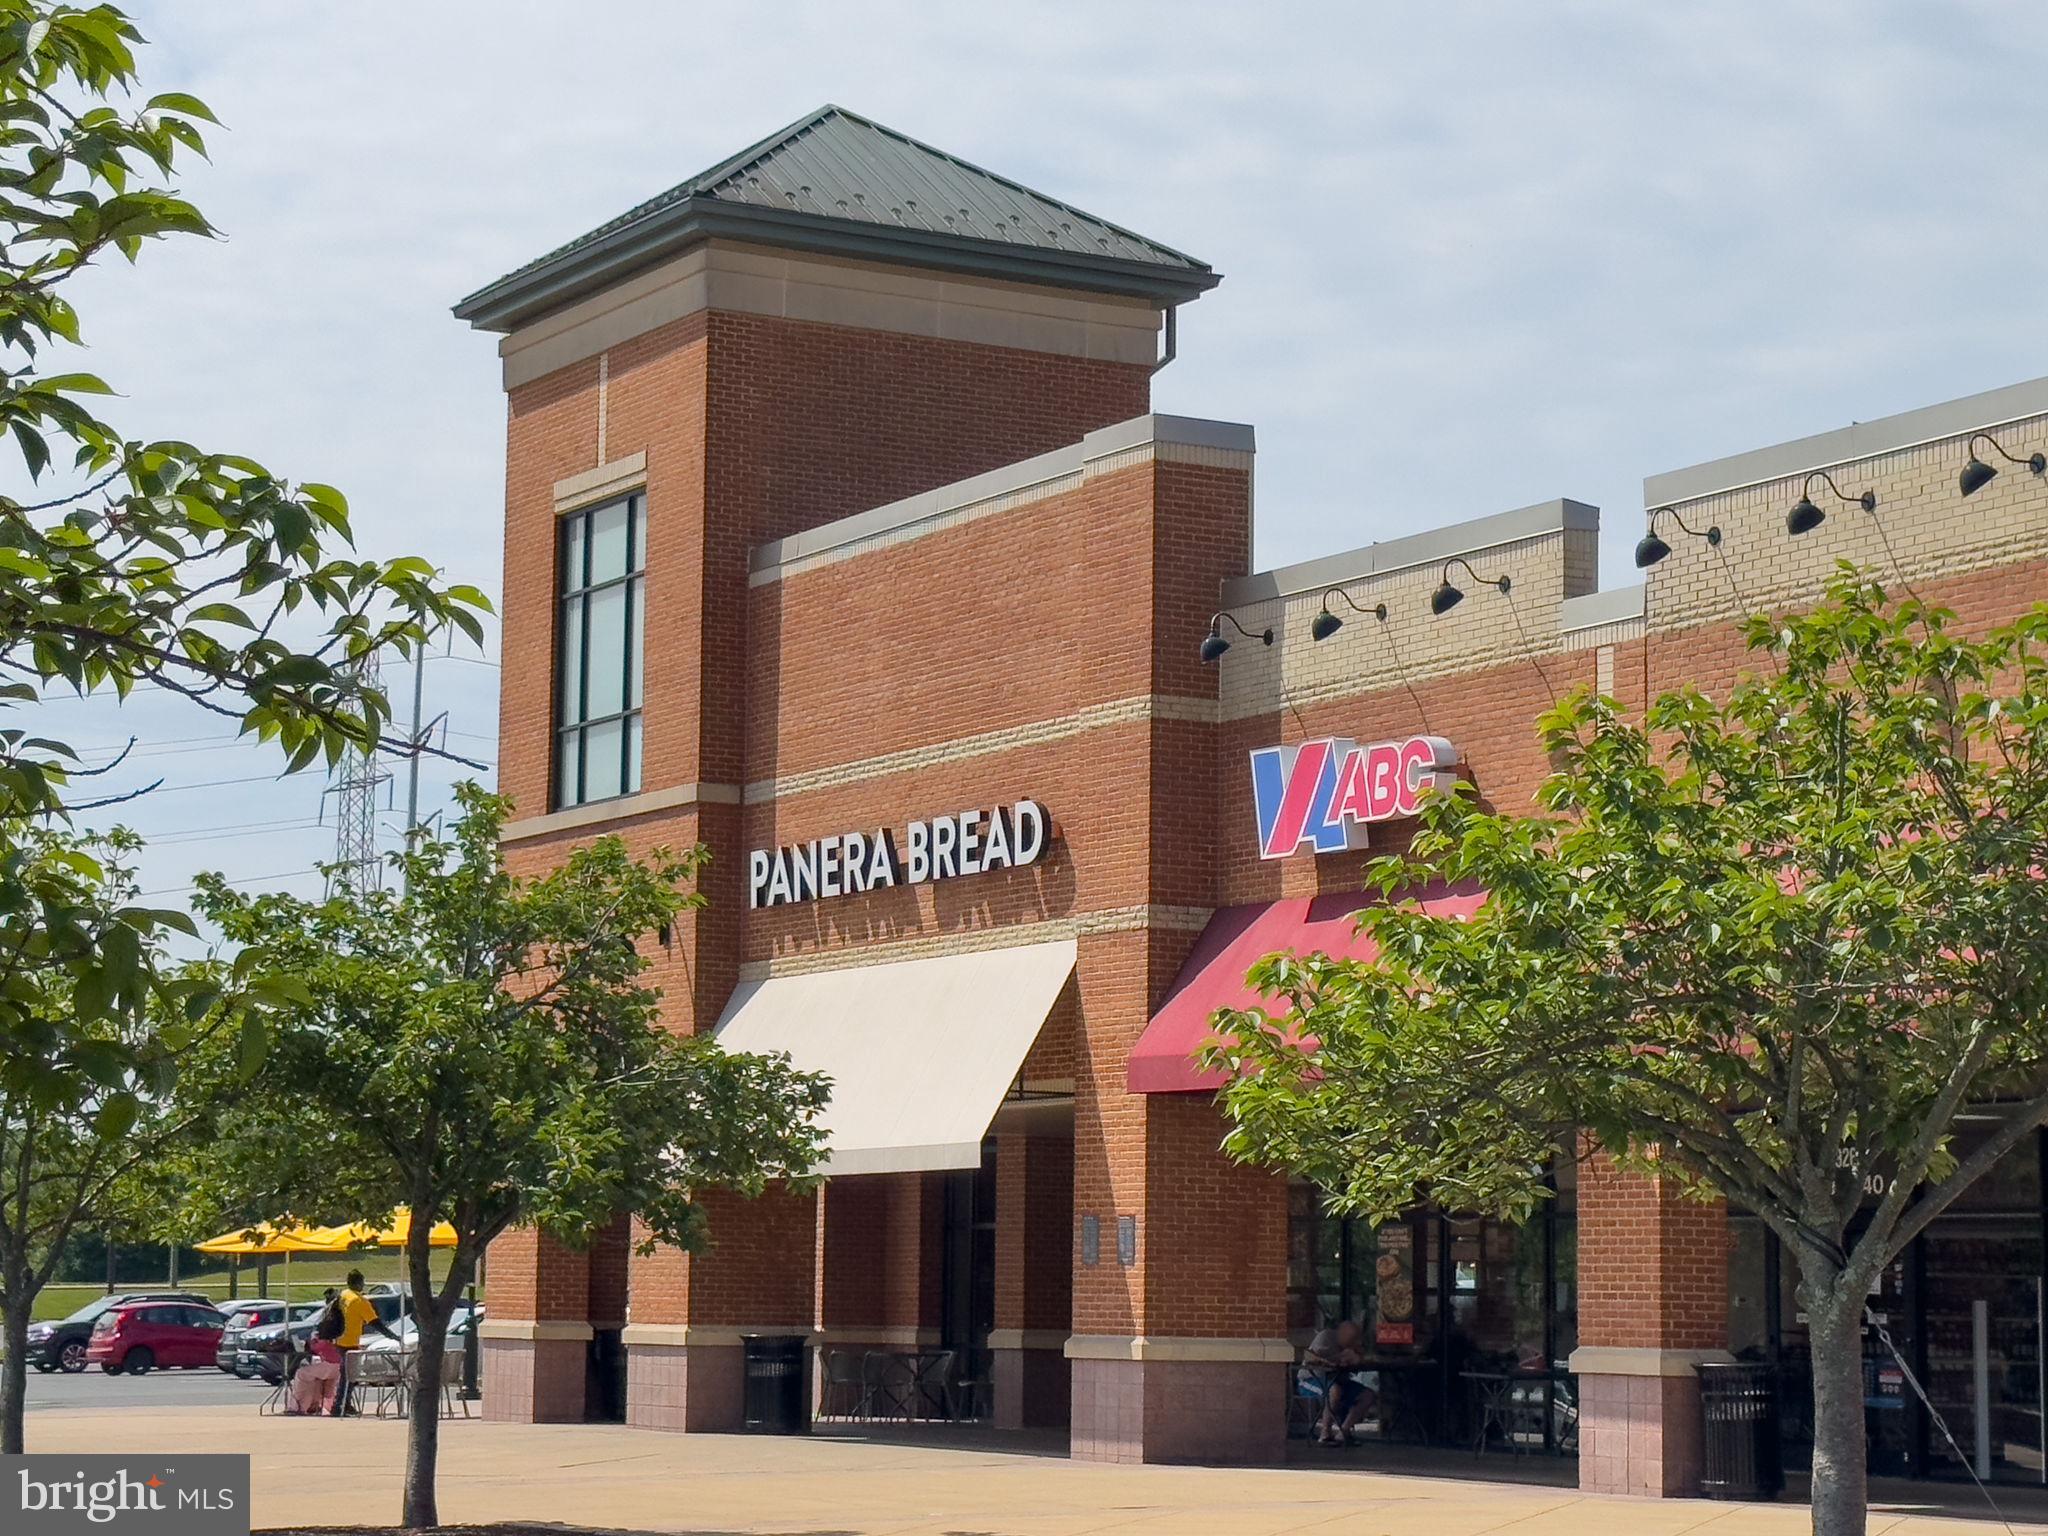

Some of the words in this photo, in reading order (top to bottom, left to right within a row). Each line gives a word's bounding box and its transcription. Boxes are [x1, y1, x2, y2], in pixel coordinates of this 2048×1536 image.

[1323, 735, 1436, 824] ABC
[750, 826, 895, 910] PANERA
[907, 799, 1045, 885] BREAD
